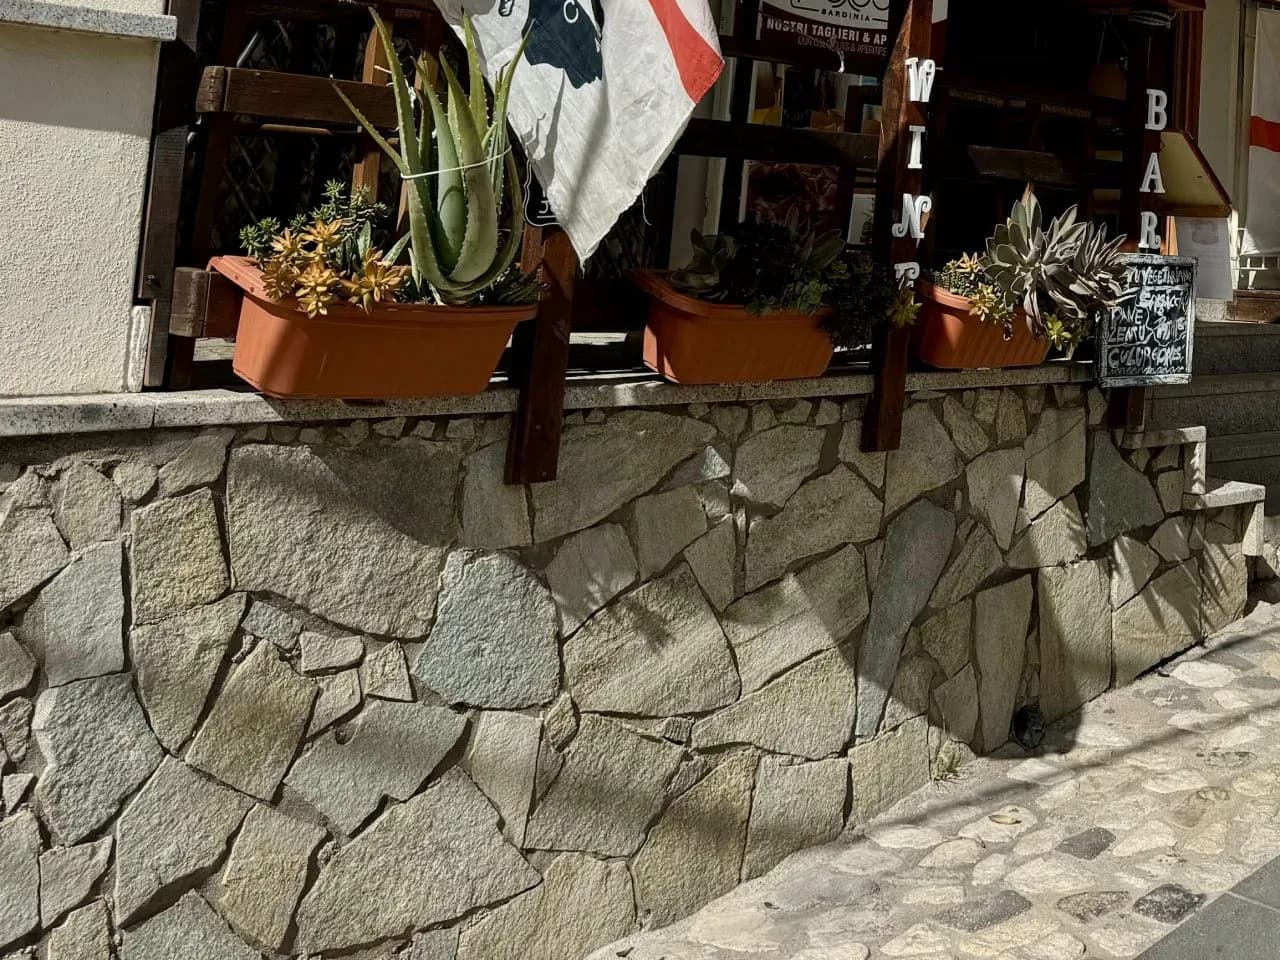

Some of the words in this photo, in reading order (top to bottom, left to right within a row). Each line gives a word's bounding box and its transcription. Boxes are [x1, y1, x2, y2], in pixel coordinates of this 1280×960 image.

[821, 8, 871, 22] SARDINIA
[766, 17, 808, 35] NOSTRI
[811, 23, 860, 43] TAGLIERI
[1138, 88, 1168, 250] BAR
[1111, 305, 1144, 326] PANE
